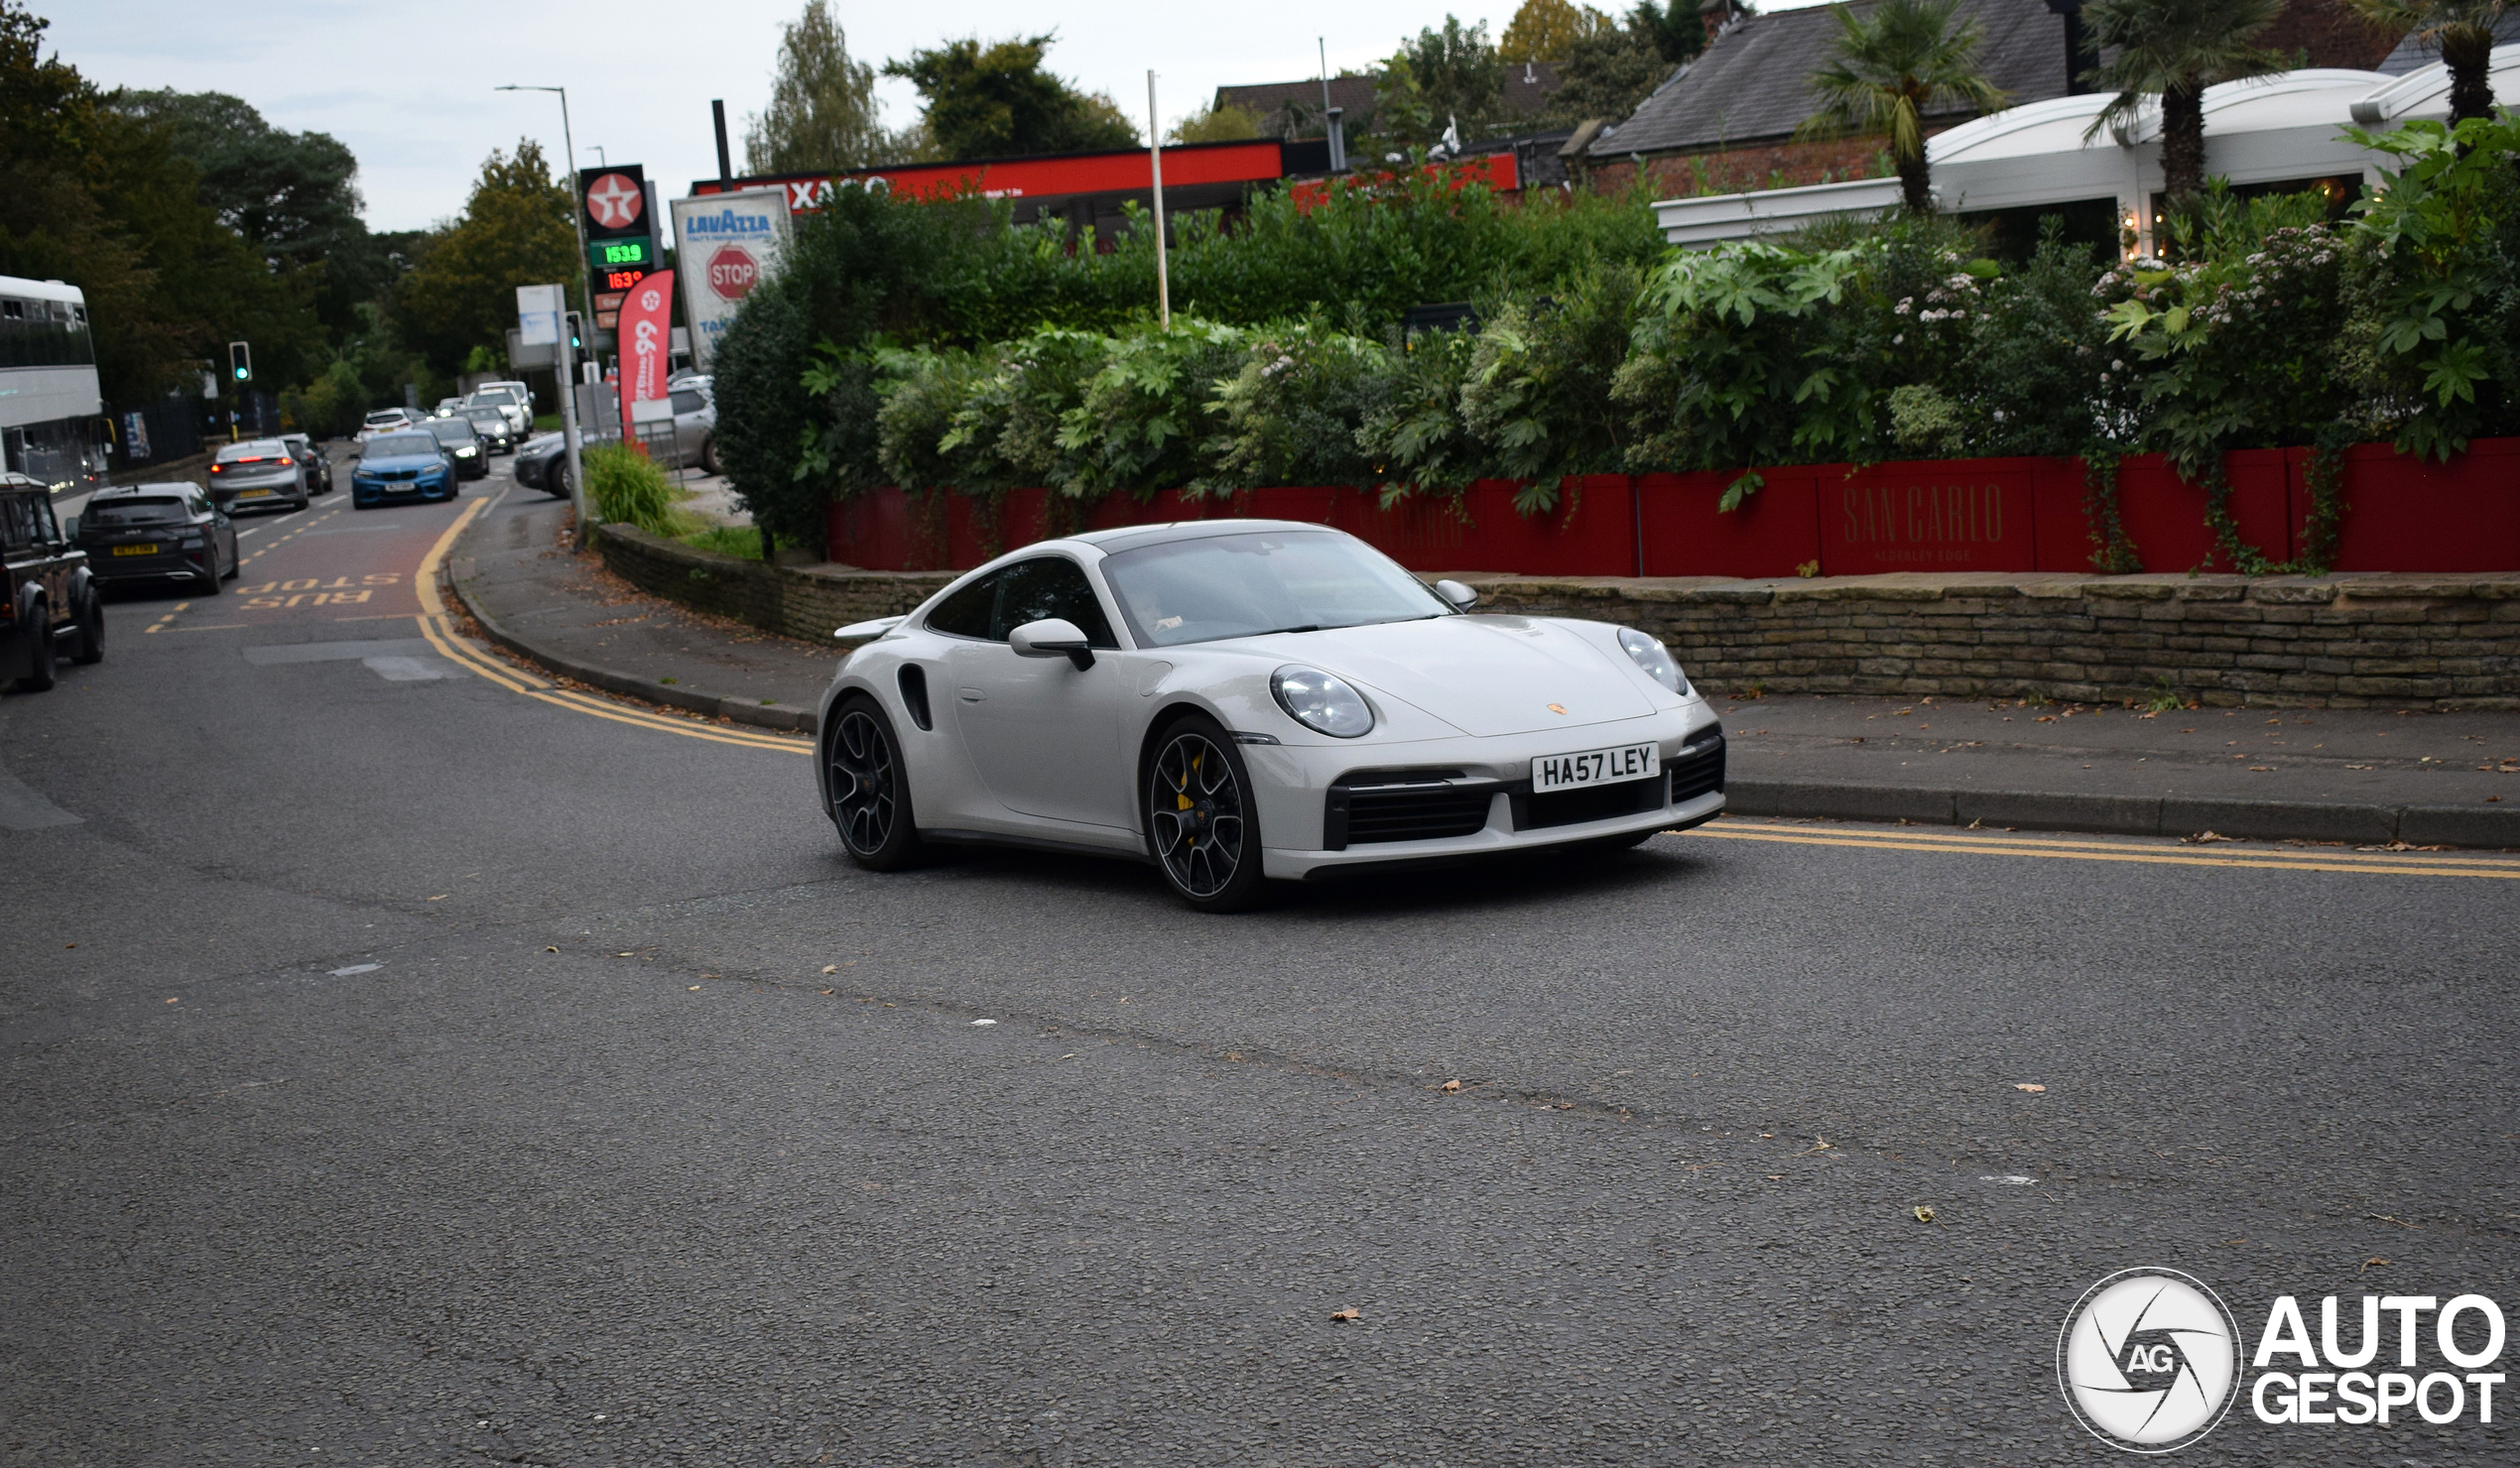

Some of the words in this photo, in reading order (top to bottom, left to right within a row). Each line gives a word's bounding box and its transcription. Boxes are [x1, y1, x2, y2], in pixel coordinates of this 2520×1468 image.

[687, 208, 771, 234] LAVAZZA
[711, 264, 754, 286] STOP
[1843, 487, 1896, 543] SAN
[1907, 483, 2002, 543] CARLO
[1874, 549, 1934, 561] ALDERLEY
[1938, 549, 1971, 561] EDGE
[235, 572, 401, 594] STOP
[239, 589, 373, 609] BUS
[1544, 753, 1603, 786] HA57
[1611, 747, 1650, 777] LEY
